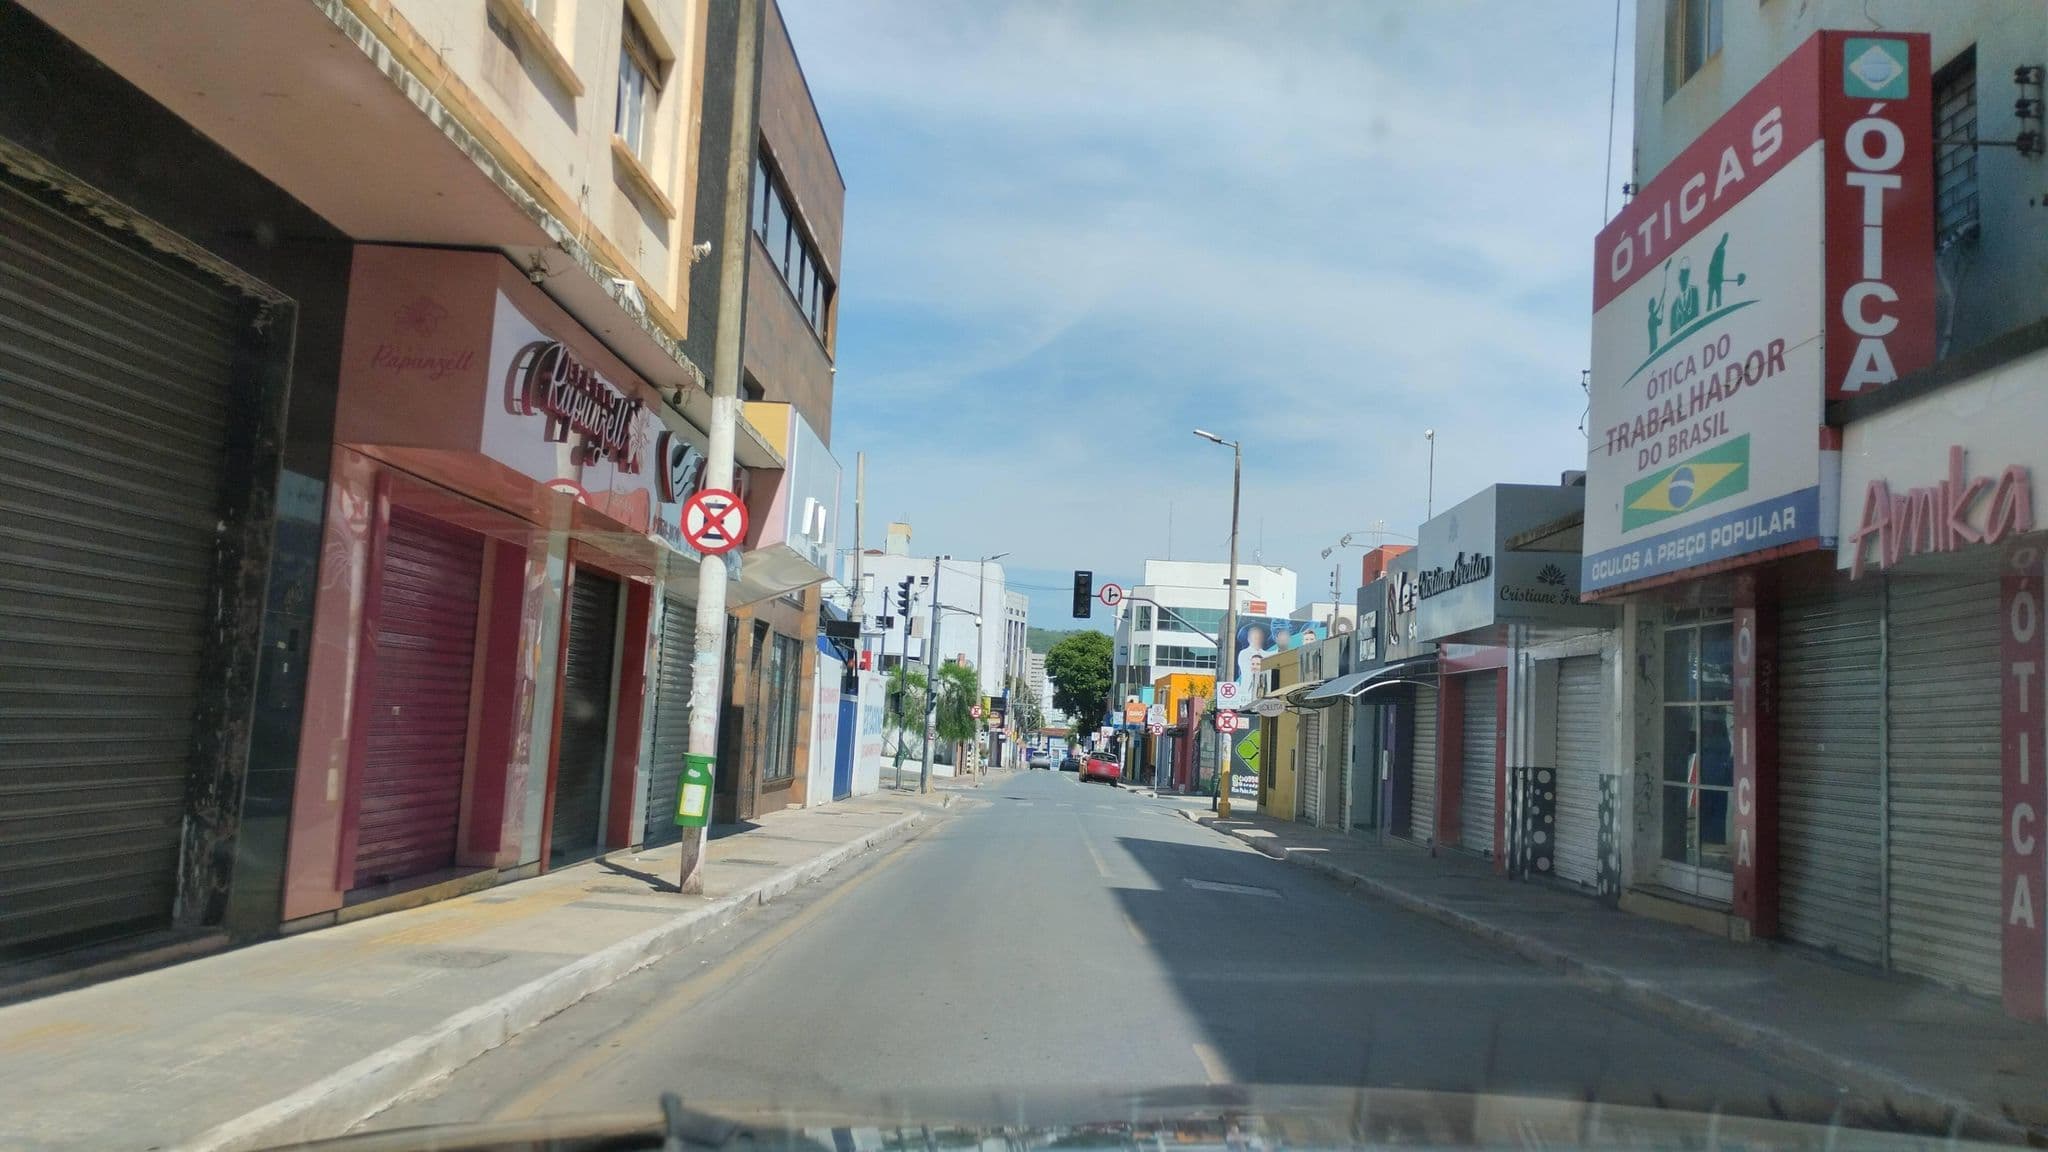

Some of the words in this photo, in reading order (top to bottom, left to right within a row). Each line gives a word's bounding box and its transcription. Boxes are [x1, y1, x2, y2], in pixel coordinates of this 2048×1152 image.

[1612, 105, 1783, 283] ÓTICAS
[1840, 102, 1906, 391] ÓTICA
[1606, 338, 1786, 457] TRABALHADOR
[1647, 354, 1697, 400] ÓTICA
[1703, 334, 1731, 370] DO
[1638, 442, 1662, 473] DO
[1668, 410, 1729, 459] BRASIL
[1500, 585, 1555, 605] Cristiane
[1644, 548, 1653, 568] A
[1657, 532, 1706, 563] PREÇO
[1711, 506, 1797, 550] POPULAR
[1738, 617, 1752, 867] ÓTICA
[2009, 577, 2036, 929] ÓTICA
